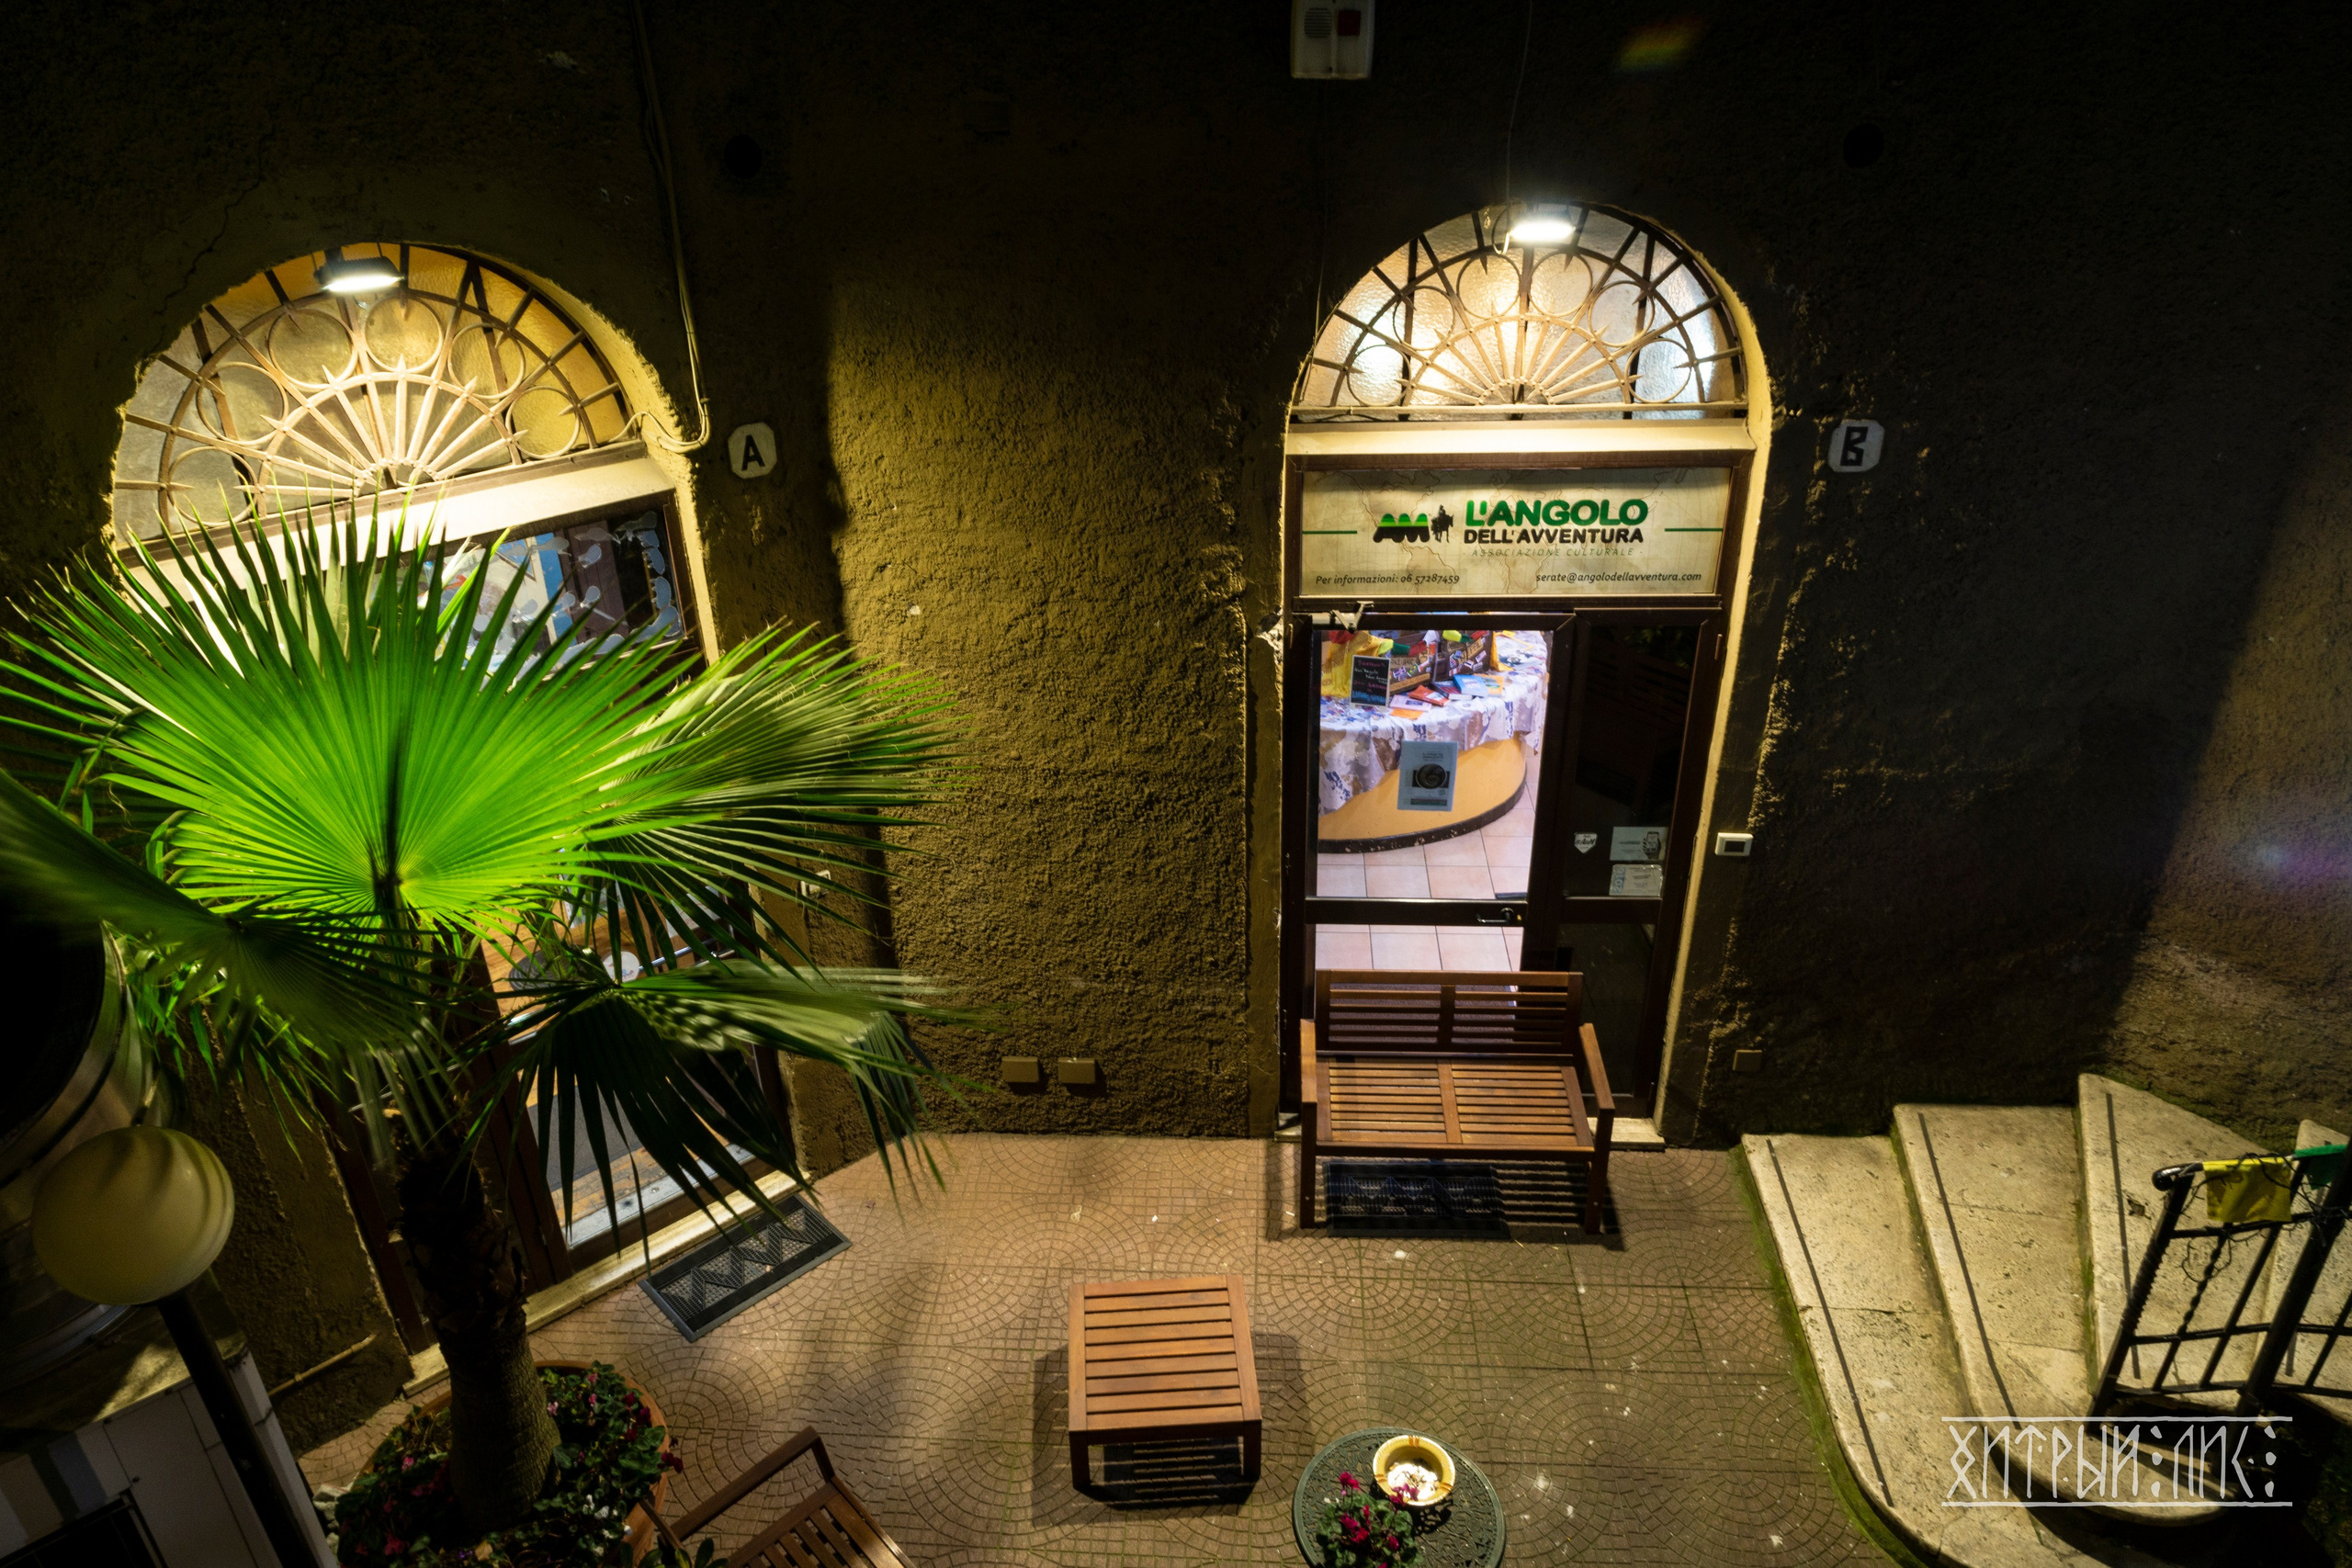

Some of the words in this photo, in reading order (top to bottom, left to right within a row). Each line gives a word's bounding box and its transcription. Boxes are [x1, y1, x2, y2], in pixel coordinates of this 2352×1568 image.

[741, 434, 765, 471] A
[1839, 426, 1869, 467] B
[1465, 499, 1649, 526] L'ANGOLO
[1464, 527, 1644, 544] DELL'AVVENTURA
[1471, 547, 1561, 557] ASSOCIAZIONE
[1566, 547, 1634, 557] CULTURALE
[1315, 575, 1332, 584] Per
[1334, 573, 1398, 586] informazioni:
[1400, 573, 1413, 583] 06
[1414, 573, 1460, 585] 57287459
[1535, 571, 1702, 584] serate@angolodellavventura.com
